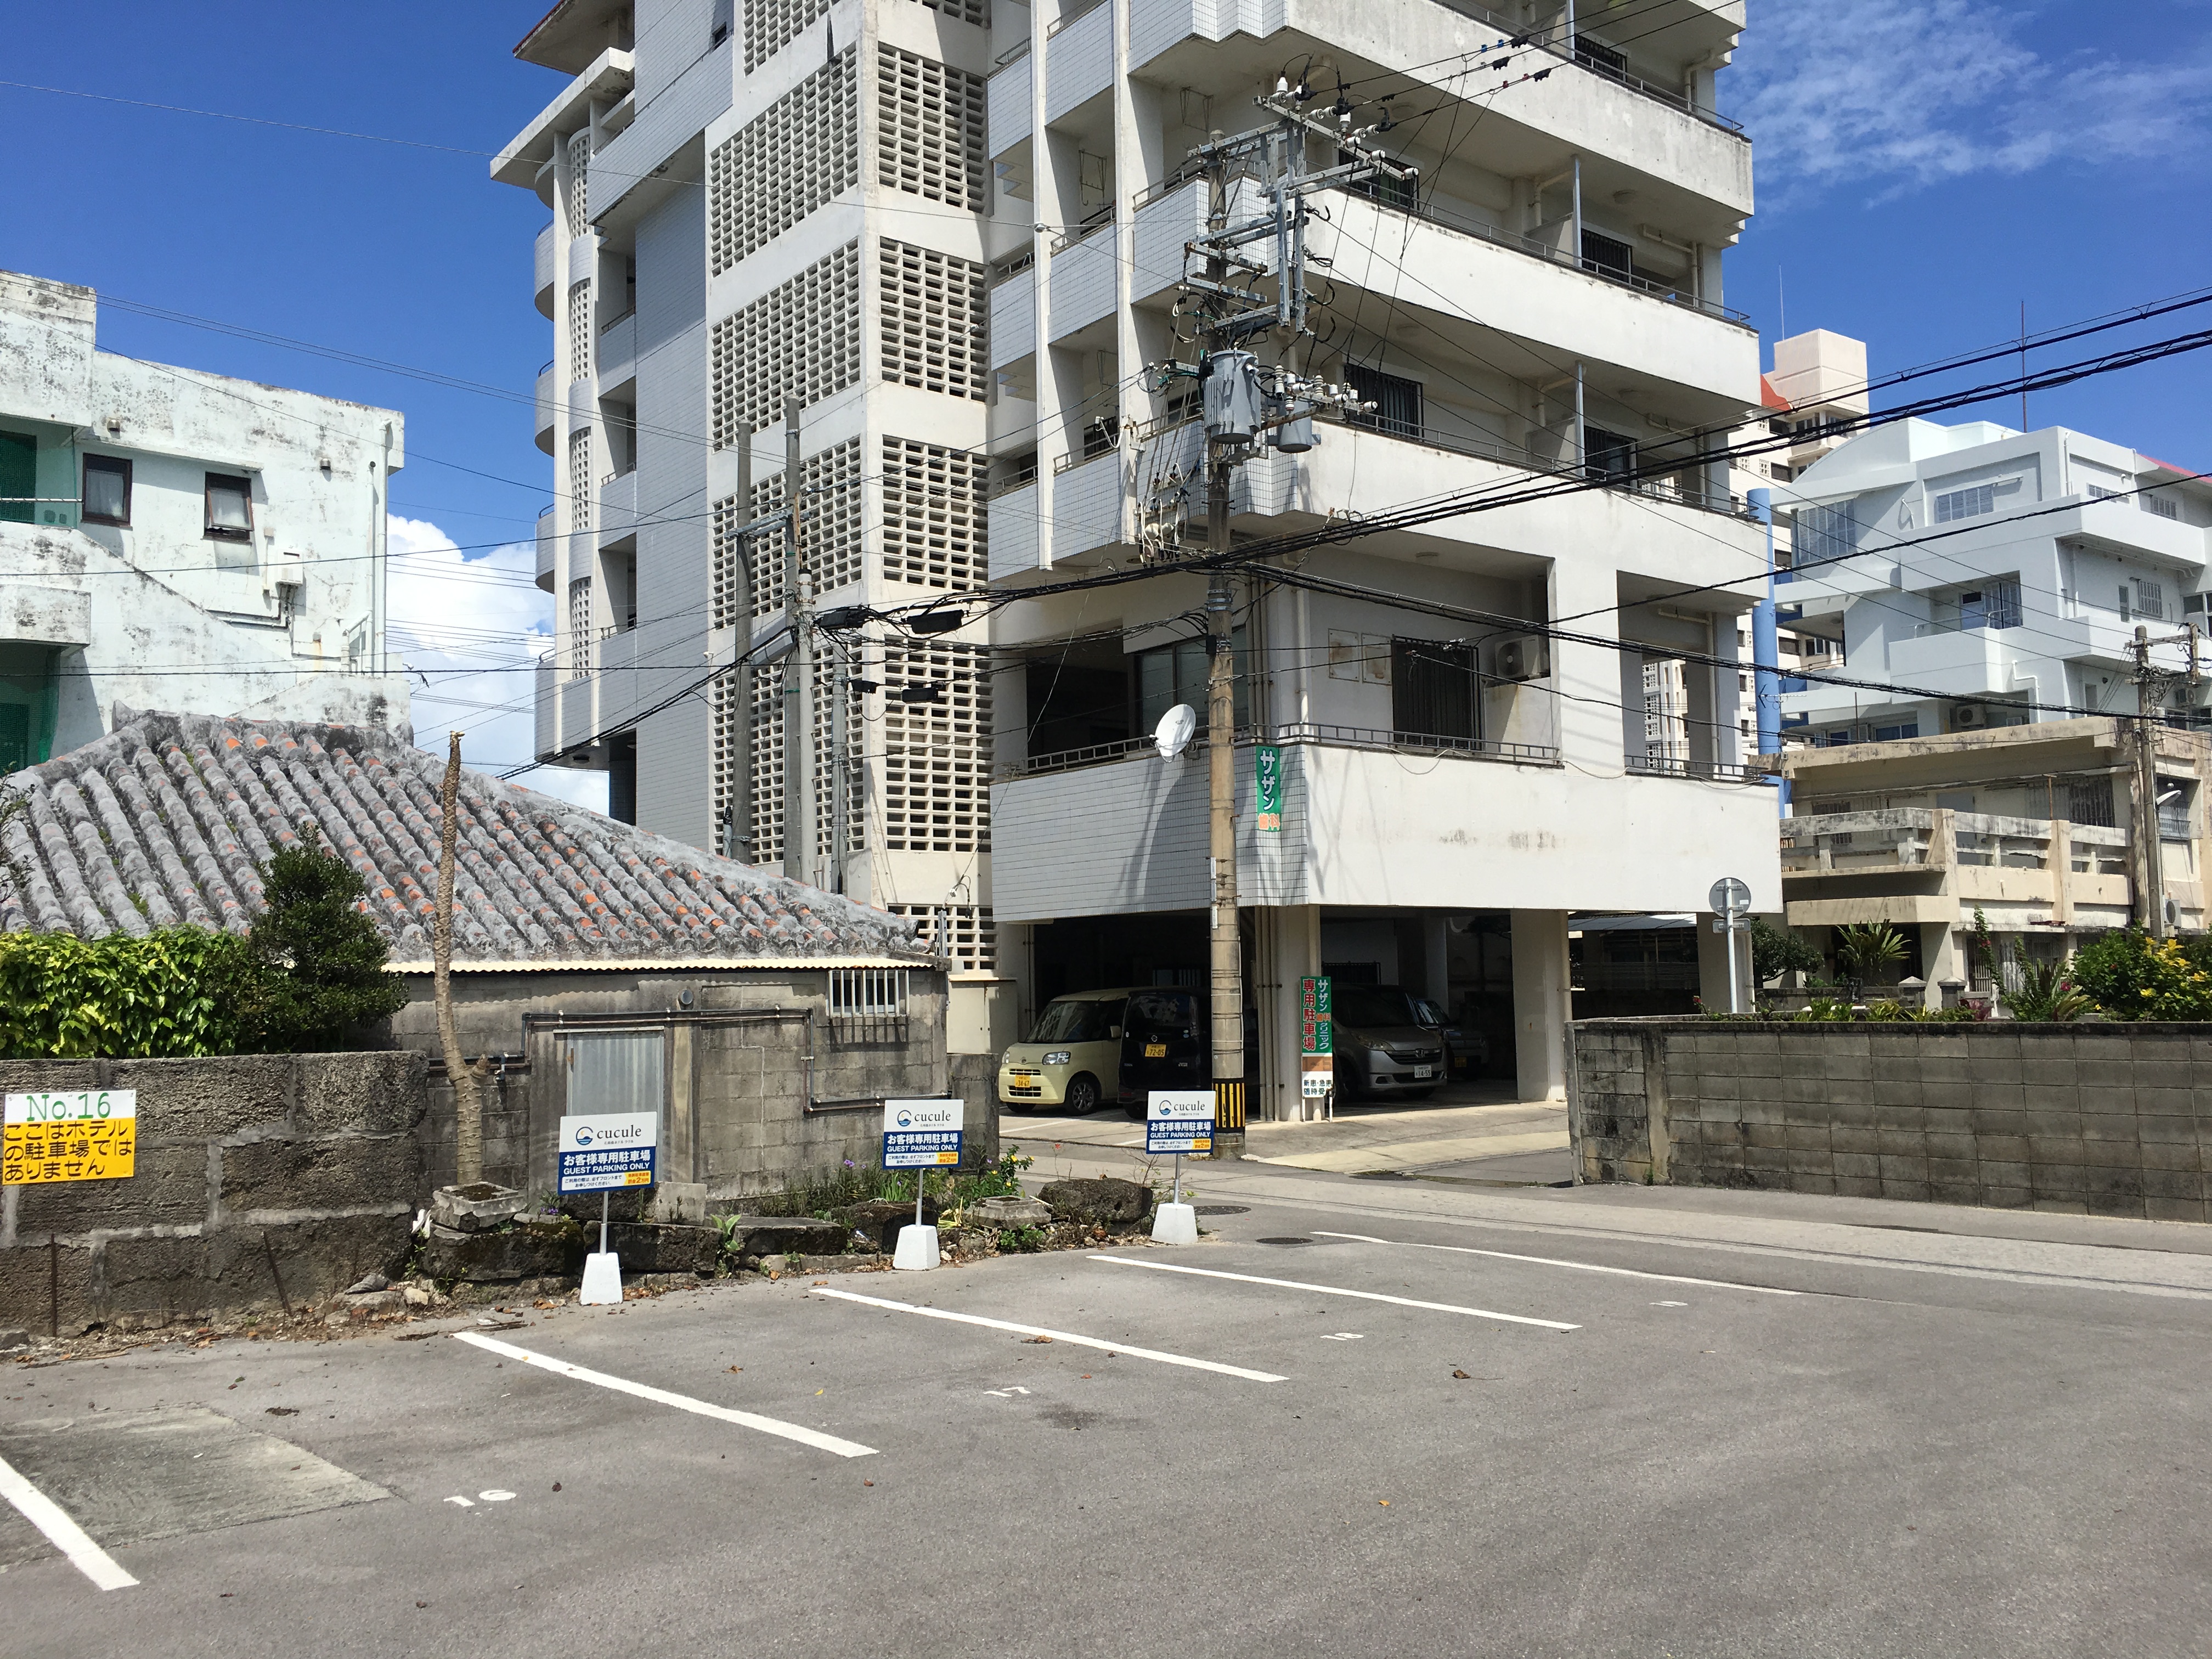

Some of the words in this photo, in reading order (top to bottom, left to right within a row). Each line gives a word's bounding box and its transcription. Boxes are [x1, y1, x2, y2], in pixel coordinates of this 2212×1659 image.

[1260, 749, 1276, 810] サザン
[1303, 979, 1317, 1051] 専用駐車場
[26, 1092, 111, 1121] No.16
[1173, 1101, 1205, 1111] cucule
[914, 1110, 951, 1122] cucule
[4, 1120, 128, 1142] ここはホテル
[597, 1125, 642, 1139] cucule
[1150, 1121, 1211, 1132] お客様専用駐車場
[887, 1133, 958, 1145] お客様専用駐車場
[4, 1139, 133, 1161] の駐車場では
[563, 1150, 651, 1166] お客様専用駐車場
[4, 1159, 105, 1181] ありません
[563, 1166, 591, 1175] GUEST
[592, 1164, 628, 1173] PARKING
[983, 1386, 1031, 1397] 17
[443, 1489, 517, 1507] 16
